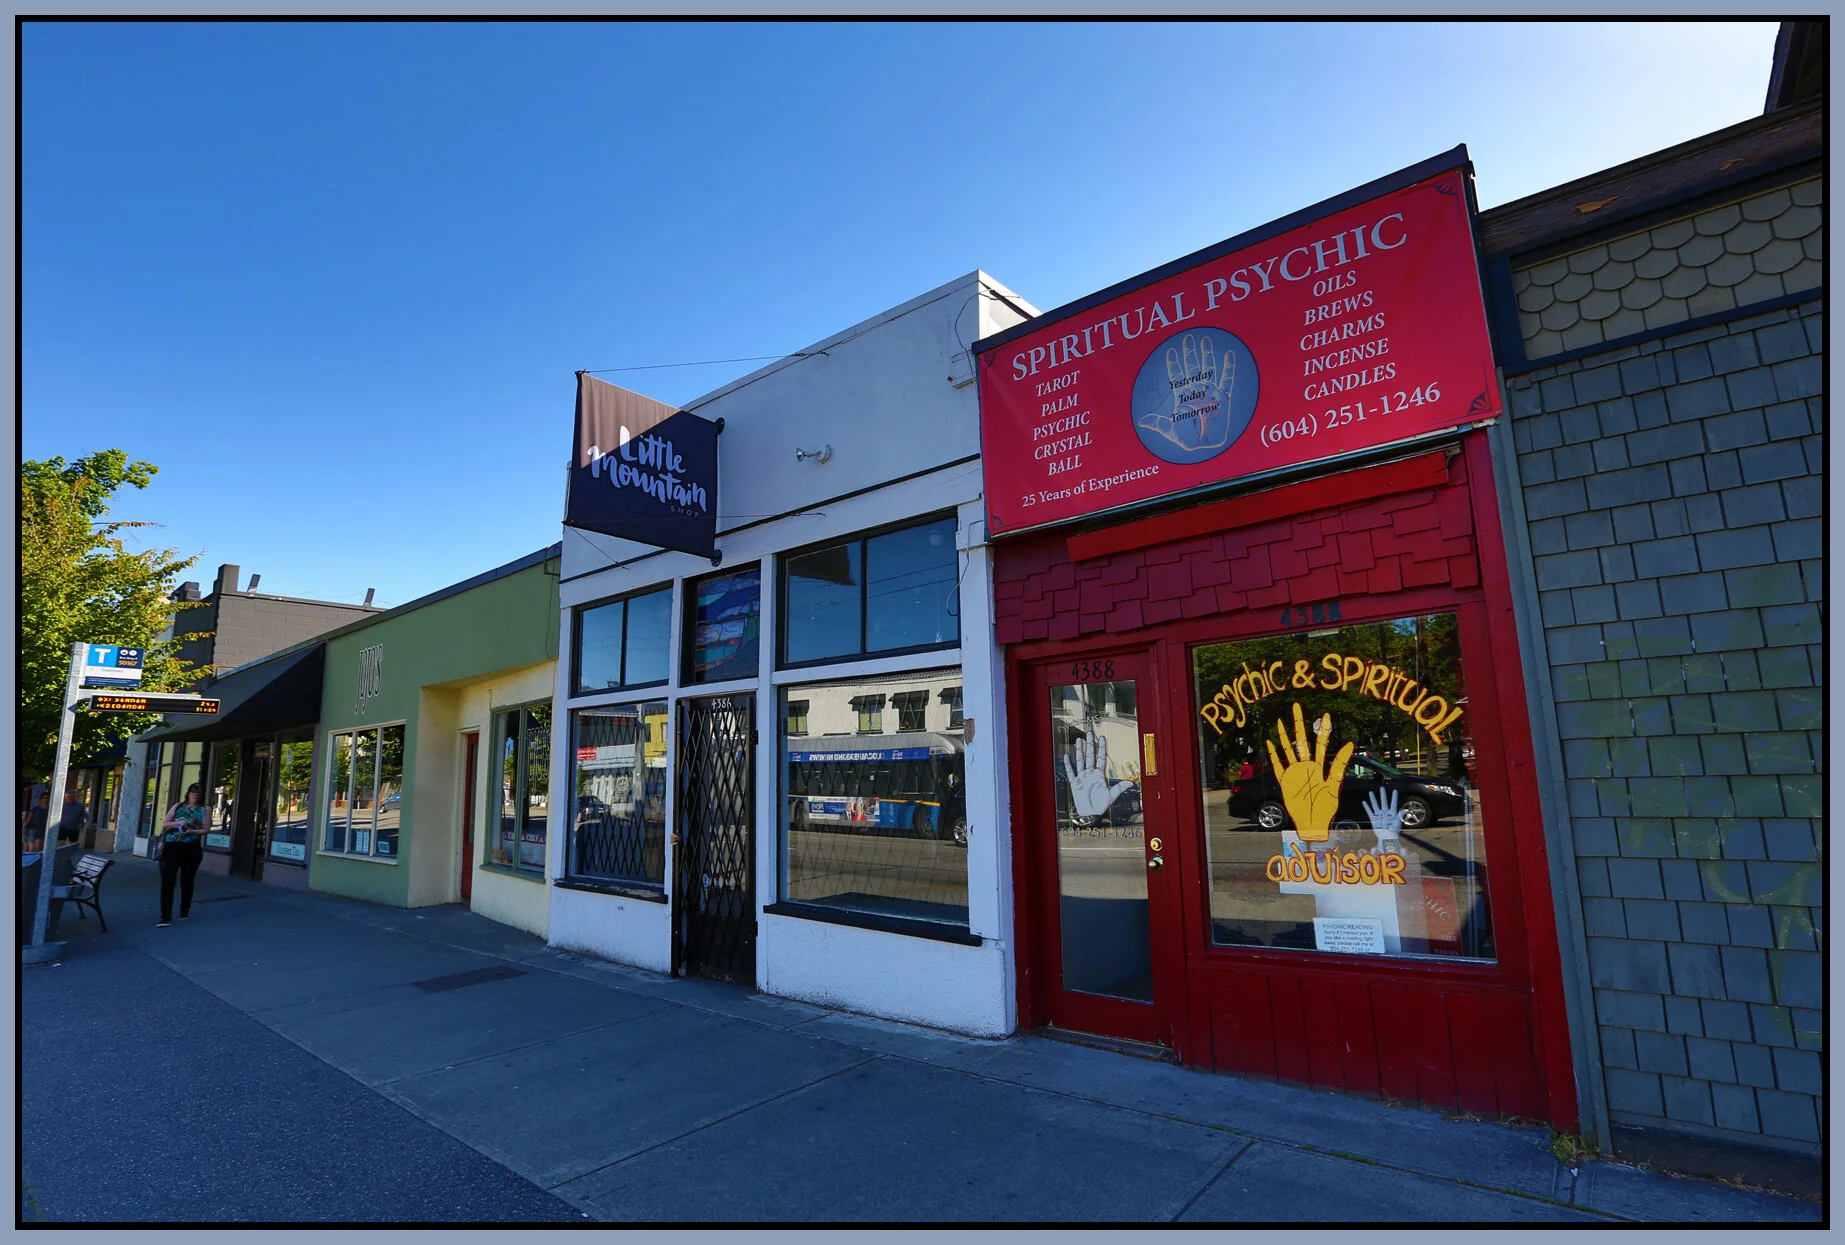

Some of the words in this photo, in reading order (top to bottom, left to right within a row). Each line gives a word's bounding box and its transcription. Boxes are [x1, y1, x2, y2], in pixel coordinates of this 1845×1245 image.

[1011, 291, 1195, 381] SPIRITUAL
[1203, 213, 1407, 312] PSYCHIC
[1312, 270, 1357, 297] OILS
[1303, 290, 1374, 326] BREWS
[1300, 312, 1385, 351] CHARMS
[1303, 338, 1389, 376] INCENSE
[1036, 370, 1080, 397] TAROT
[1169, 369, 1214, 391] Yesterday
[1303, 362, 1396, 401] CANDLES
[1041, 393, 1079, 417] PALM
[1178, 388, 1208, 404] Today
[1033, 411, 1090, 441] PSYCHIC
[1171, 403, 1220, 423] Tomorrow
[1260, 413, 1318, 448] (604)
[1325, 382, 1441, 429] 251-1246
[619, 425, 686, 474] Little
[1034, 432, 1093, 461] CRYSTAL
[587, 445, 706, 512] Mountain
[1048, 455, 1082, 476] BALL
[1022, 495, 1036, 508] 25
[1038, 489, 1072, 504] Years
[1073, 481, 1087, 495] of
[1089, 465, 1160, 492] Experience
[670, 505, 700, 517] SHOP
[94, 648, 112, 664] T
[1071, 660, 1114, 681] 4388
[1291, 658, 1316, 689] &
[1059, 826, 1143, 839] 604-251-1246
